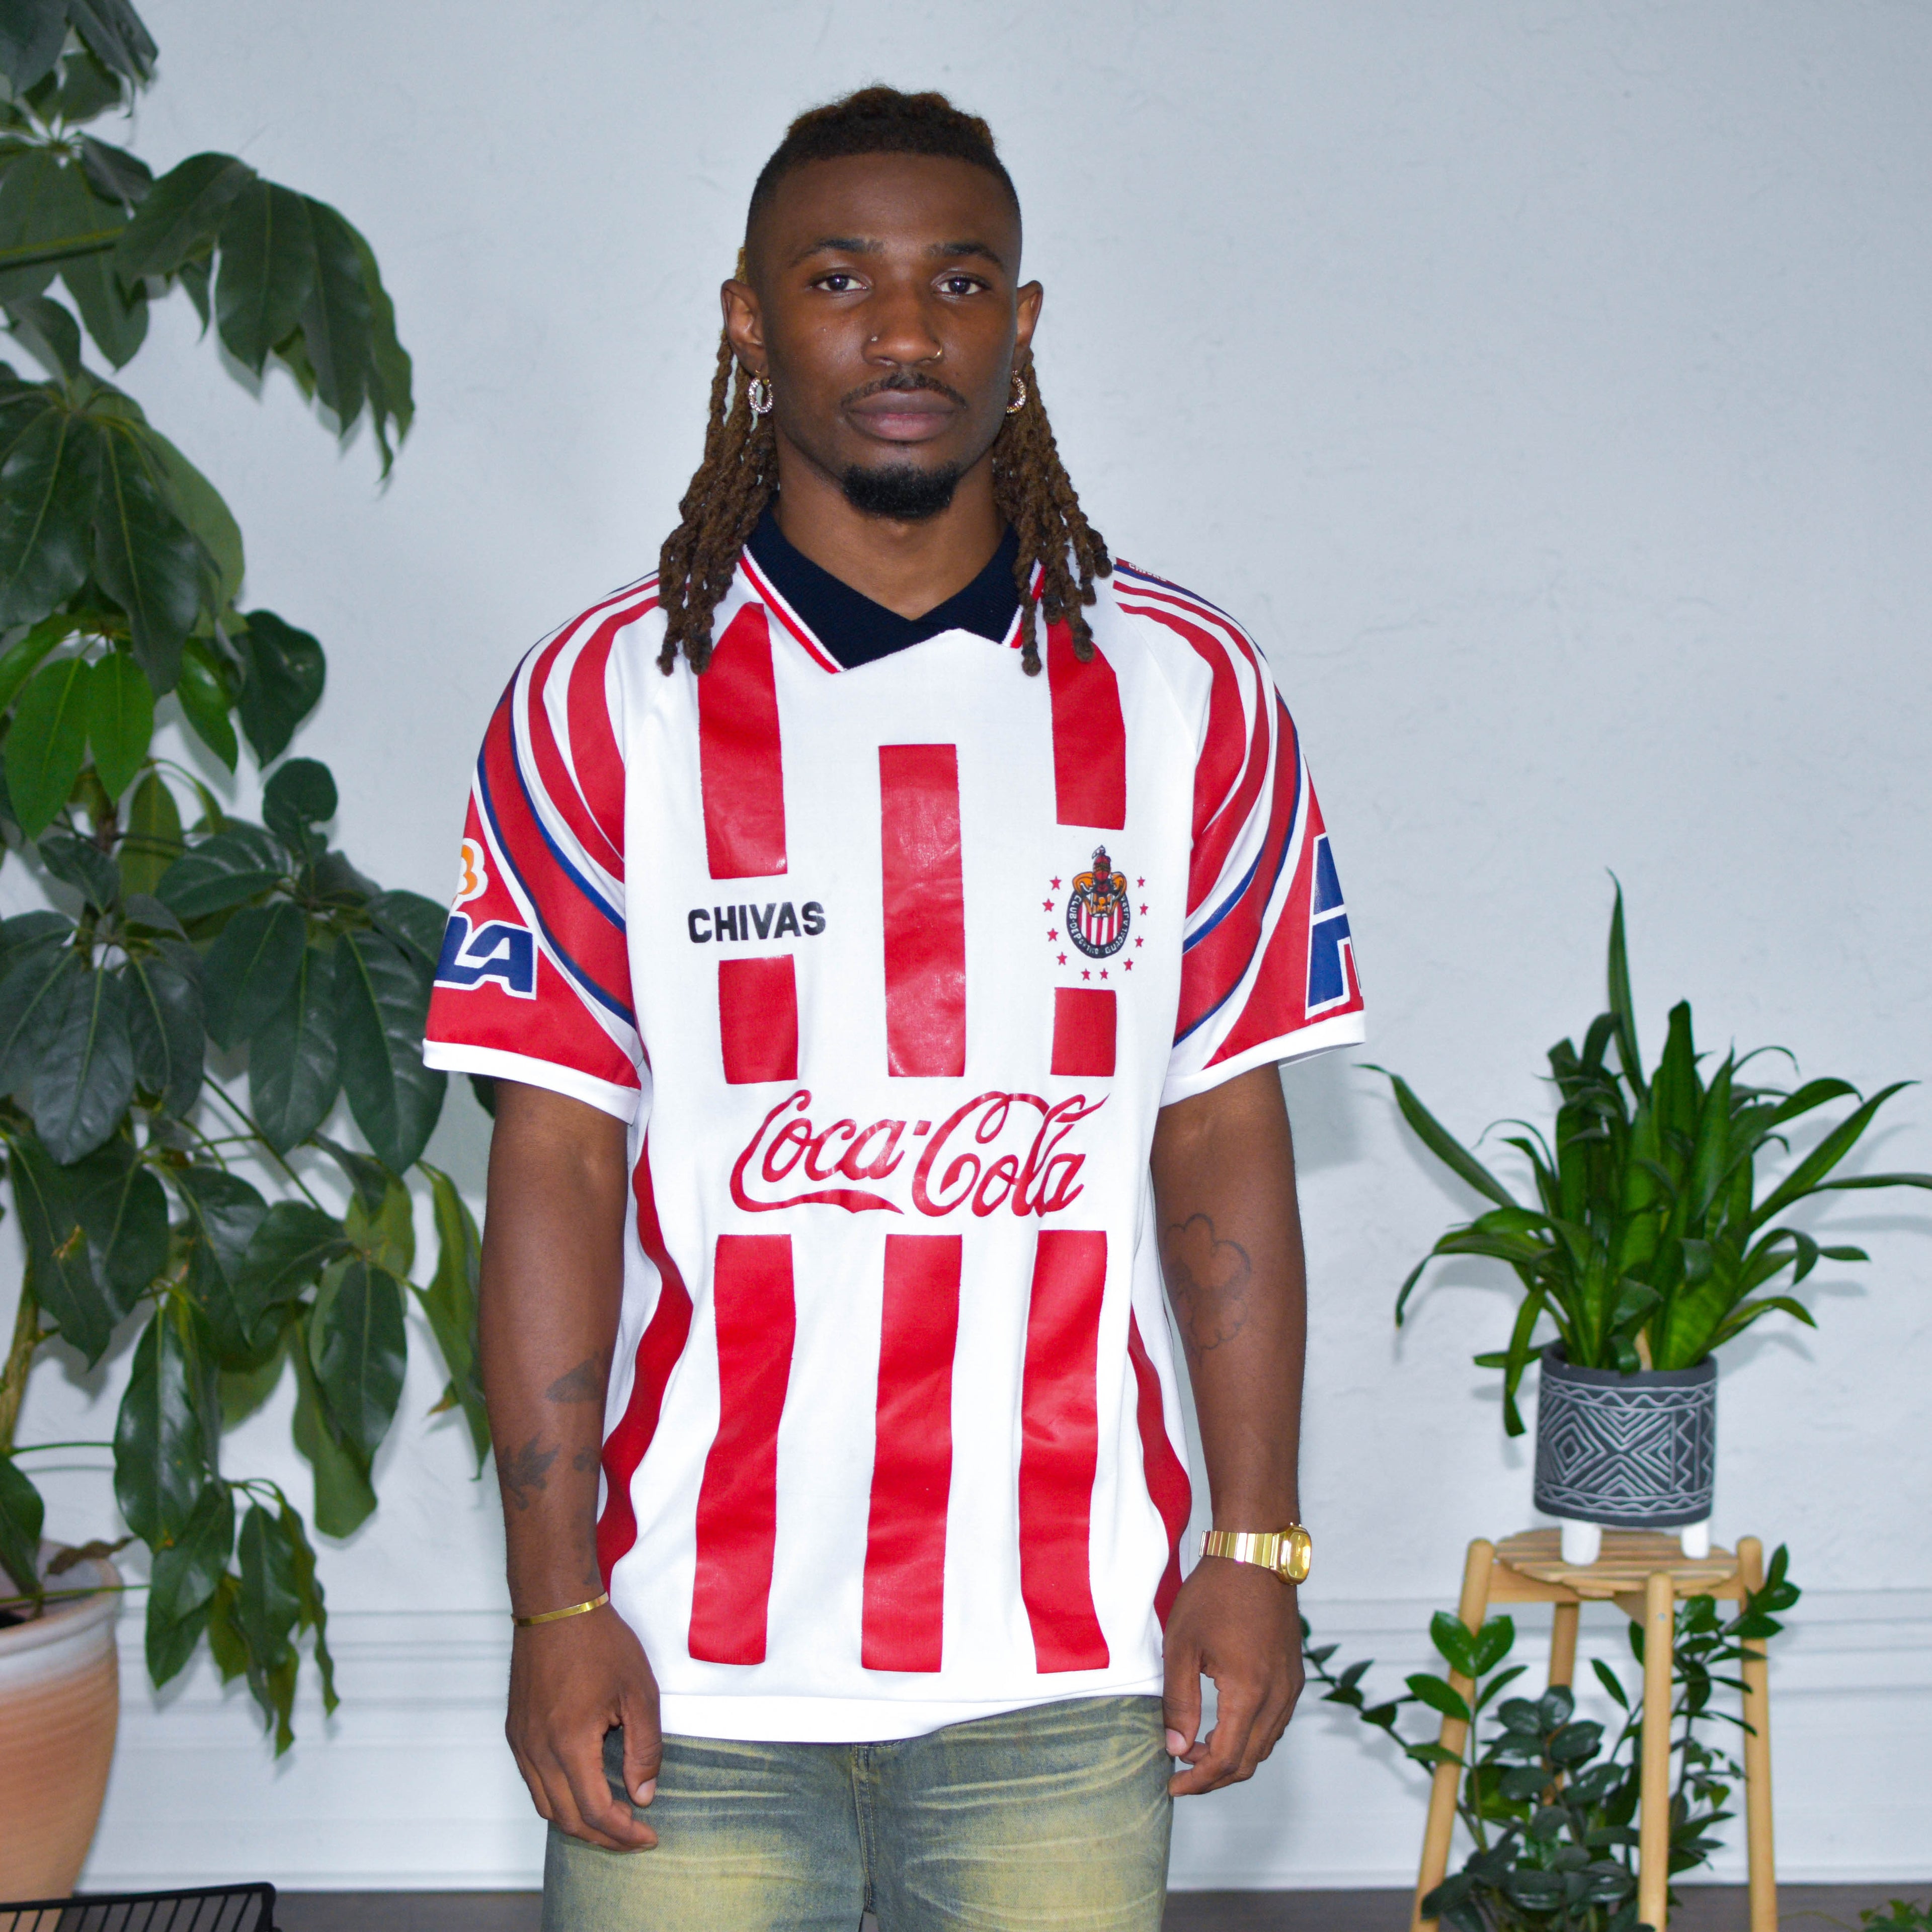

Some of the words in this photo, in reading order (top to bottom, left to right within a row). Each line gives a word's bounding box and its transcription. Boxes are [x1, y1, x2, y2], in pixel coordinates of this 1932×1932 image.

[688, 901, 826, 943] CHIVAS
[1069, 895, 1082, 919] CLUB
[730, 1089, 1110, 1217] Coca-Cola
